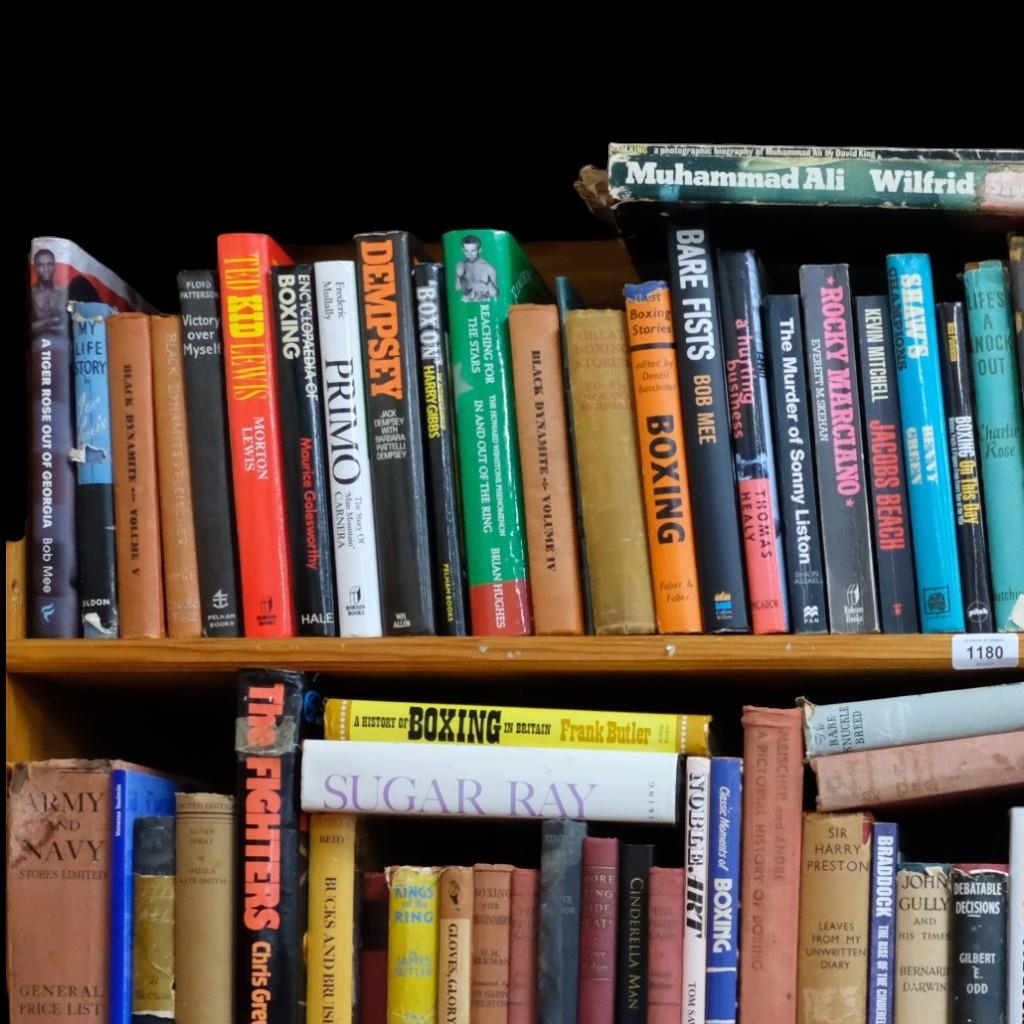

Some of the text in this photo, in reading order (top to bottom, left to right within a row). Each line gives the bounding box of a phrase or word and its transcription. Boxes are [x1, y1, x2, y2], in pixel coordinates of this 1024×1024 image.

[660, 147, 712, 157] photographic
[714, 148, 753, 157] biography
[765, 148, 811, 156] Muhammad
[836, 150, 857, 158] David
[859, 151, 876, 159] King
[625, 161, 800, 190] Muhammad
[803, 167, 845, 191] Ali
[868, 168, 975, 195] Wilfrid
[277, 273, 300, 360] BOXING
[360, 239, 403, 400] DEMPSEY
[78, 321, 96, 335] MY
[224, 254, 268, 401] TED KID LEWIS
[676, 229, 717, 445] BARE FISTS BOB MEE
[76, 341, 103, 357] LIFE
[74, 359, 107, 376] STORY
[325, 357, 362, 485] PRIMO
[780, 317, 810, 565] The Murder of Sonny Liston
[41, 338, 53, 594] A TIGER ROSE OUT OF GEORGIA Bob Mee
[966, 645, 1004, 660] 1180
[353, 706, 651, 745] A HISTORY OF BOXING IN BRITAIN Frank Butler
[322, 773, 597, 819] SUGAR RAY
[828, 827, 848, 838] SIR
[243, 757, 282, 931] FIGHTERS
[815, 843, 861, 856] HARRY
[807, 860, 869, 872] PRESTON
[875, 836, 894, 918] BRADDOCK
[954, 881, 1002, 895] DEBATABLE
[955, 900, 1001, 915] DECISIONS
[250, 940, 272, 986] Chris
[959, 951, 996, 965] GILBERT
[973, 967, 983, 979] E.
[19, 985, 104, 998] GENERAL
[966, 982, 988, 995] ODD
[19, 1003, 101, 1016] PRICE LIST
